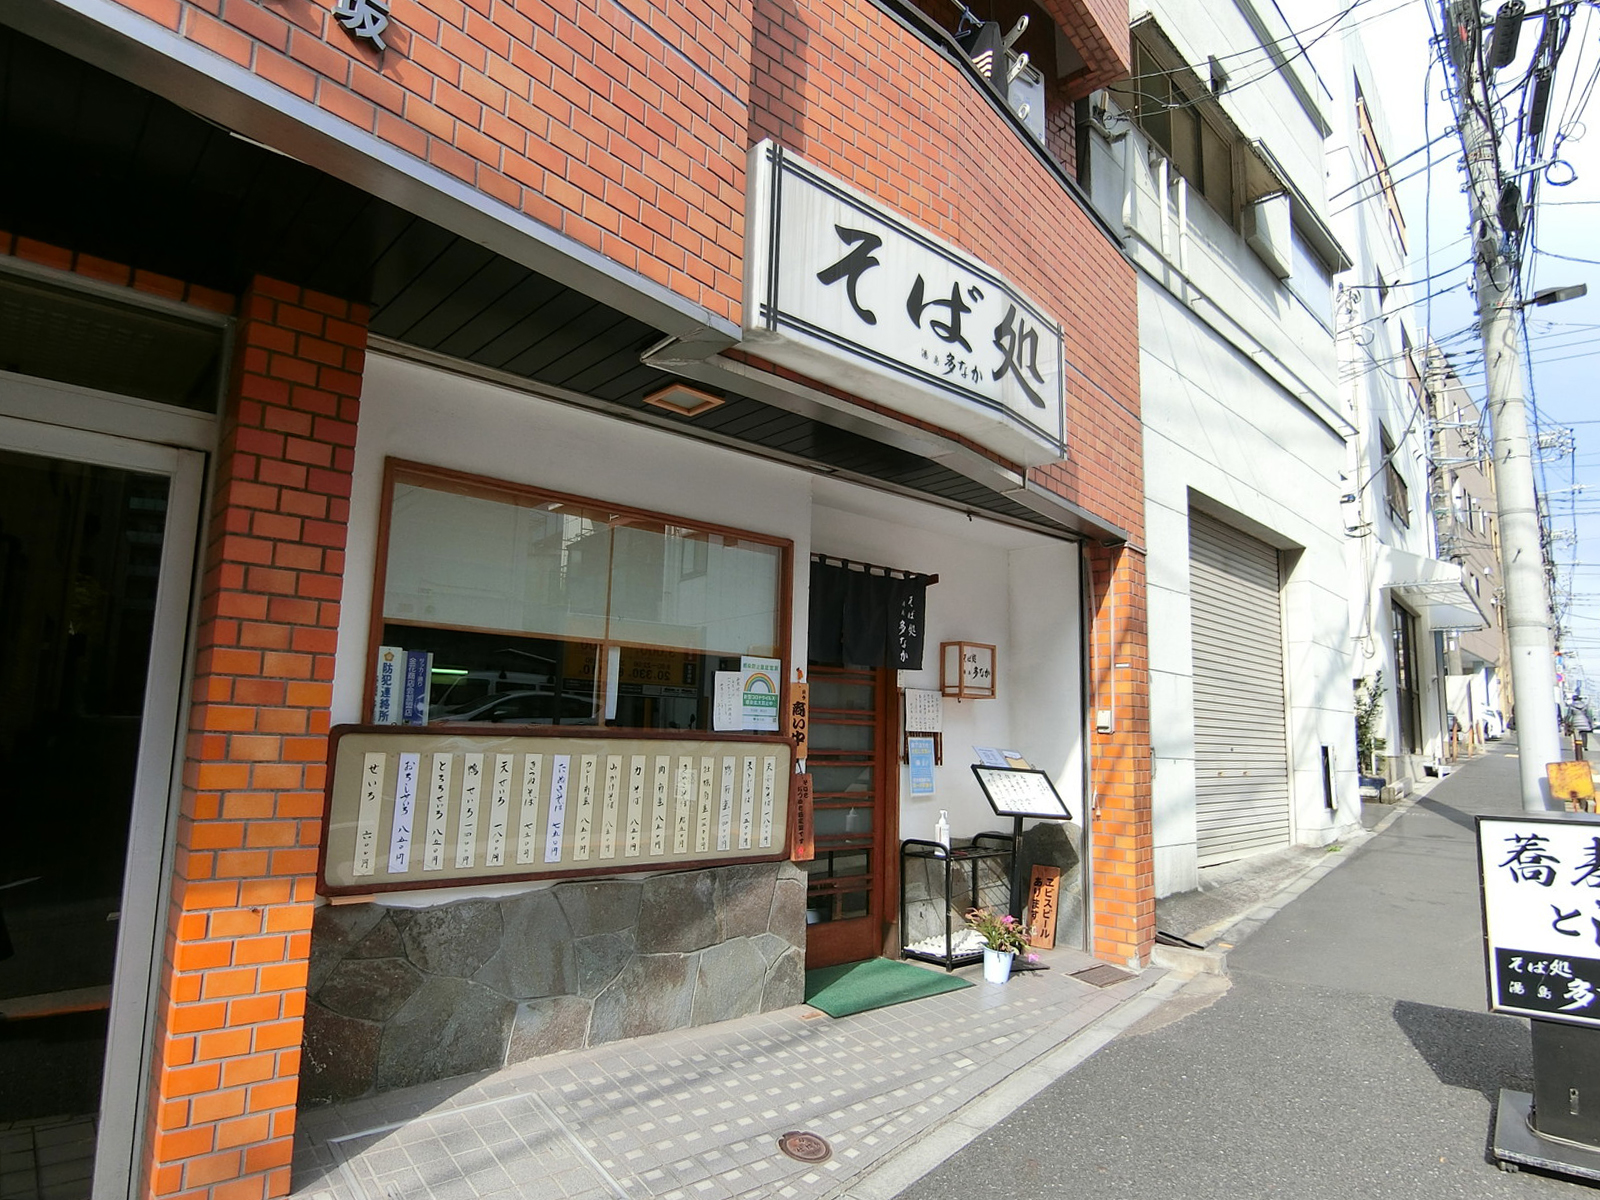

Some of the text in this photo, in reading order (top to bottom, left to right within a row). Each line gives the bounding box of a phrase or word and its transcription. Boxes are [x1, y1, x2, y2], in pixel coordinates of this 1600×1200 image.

[816, 223, 1046, 409] そば処
[907, 595, 917, 637] そば処
[377, 662, 394, 722] 防犯連絡所
[367, 763, 380, 801] せいろ
[1031, 877, 1042, 920] あります
[1550, 899, 1600, 947] と
[1508, 956, 1573, 979] そば処
[1508, 977, 1600, 1010] 湯島多
